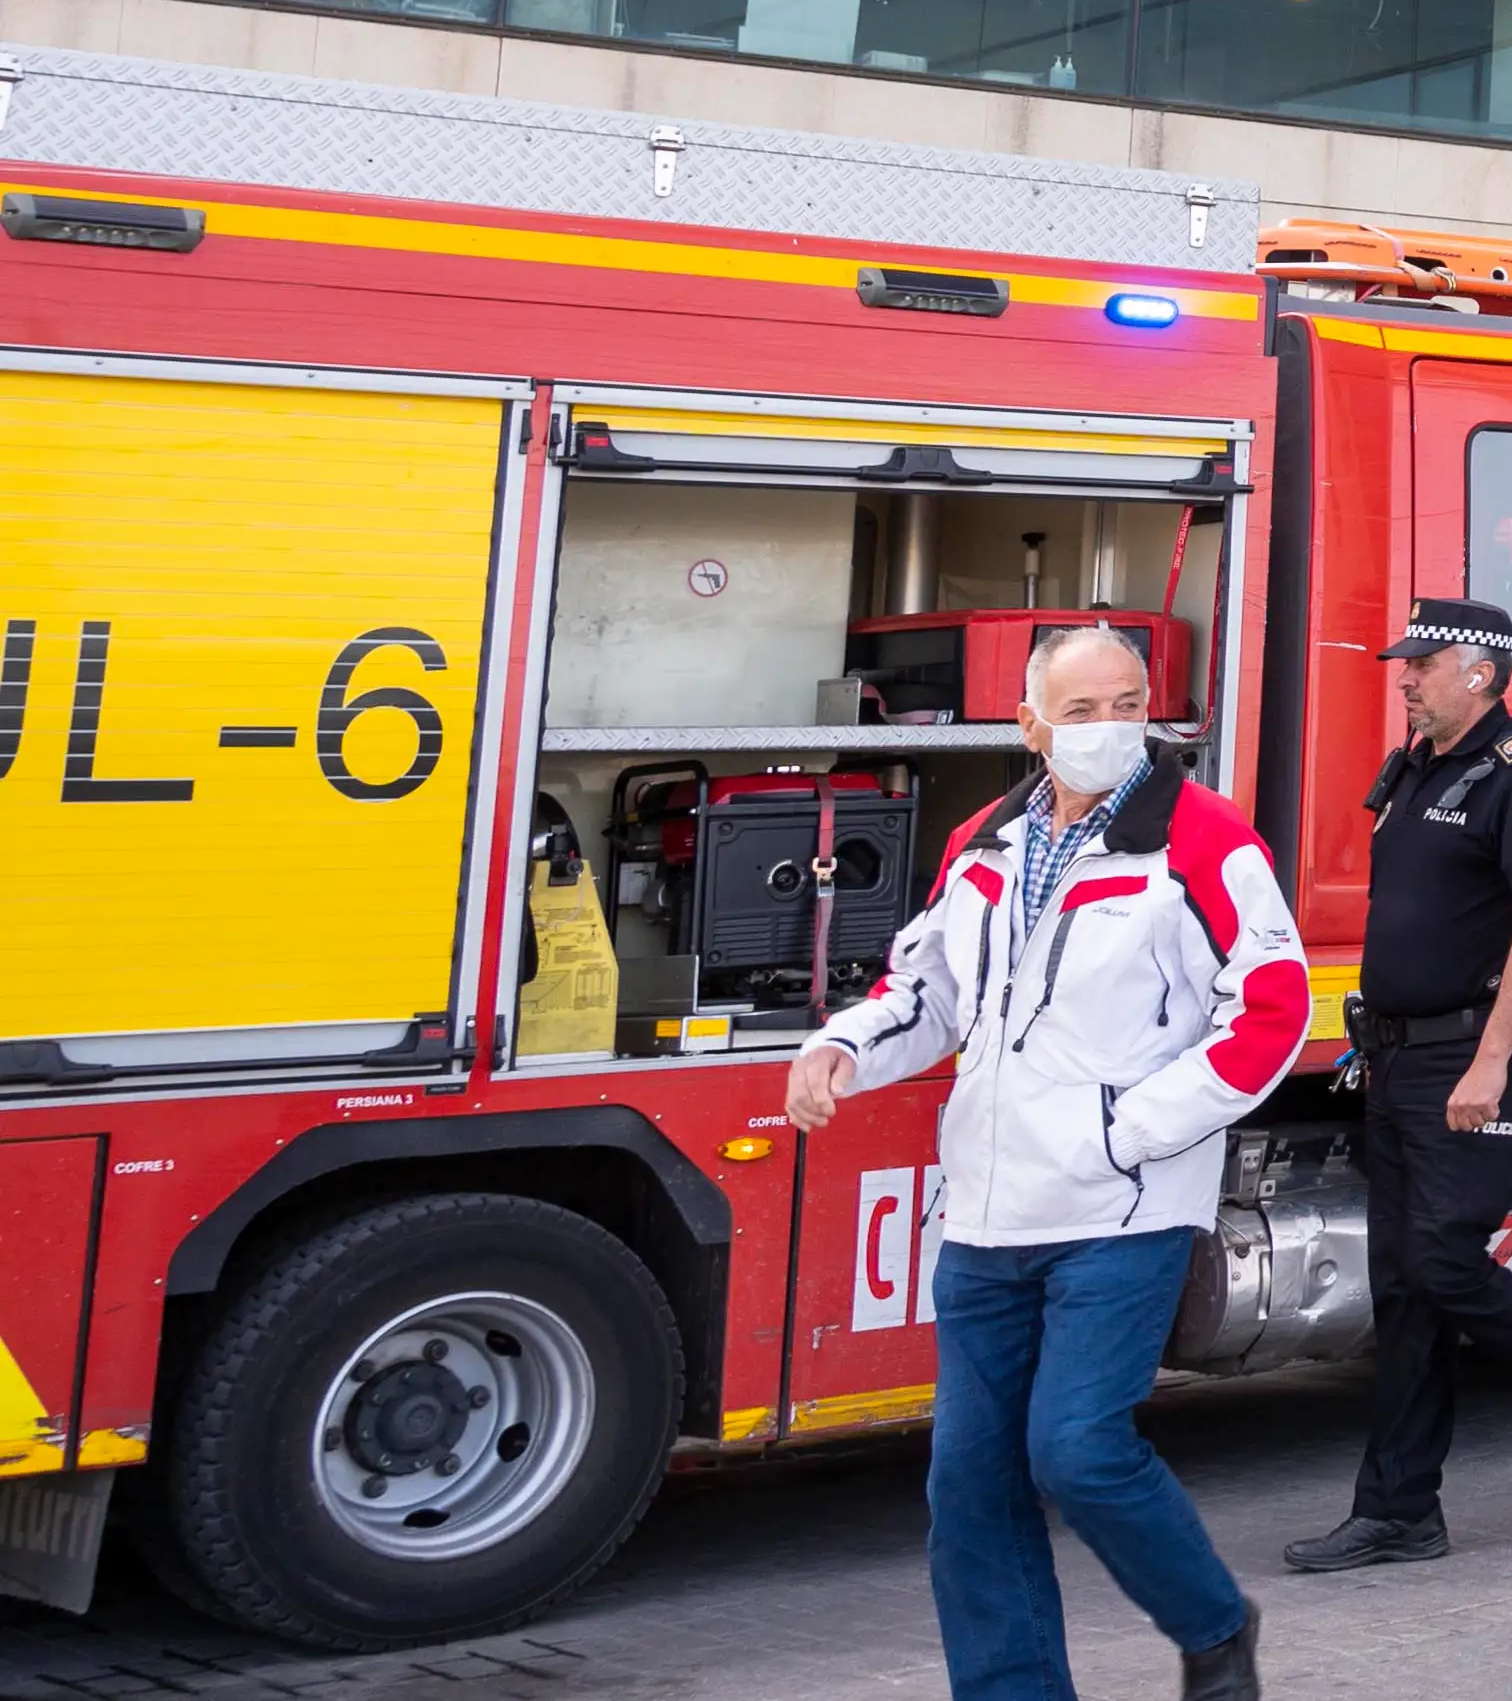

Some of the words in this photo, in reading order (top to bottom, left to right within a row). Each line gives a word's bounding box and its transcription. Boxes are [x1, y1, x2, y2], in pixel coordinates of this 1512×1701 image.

[0, 620, 448, 803] L-6
[336, 1095, 403, 1109] PERSIANA
[404, 1094, 414, 1104] 3
[748, 1115, 788, 1128] COFRE
[114, 1160, 163, 1175] COFRE
[165, 1159, 175, 1171] 3
